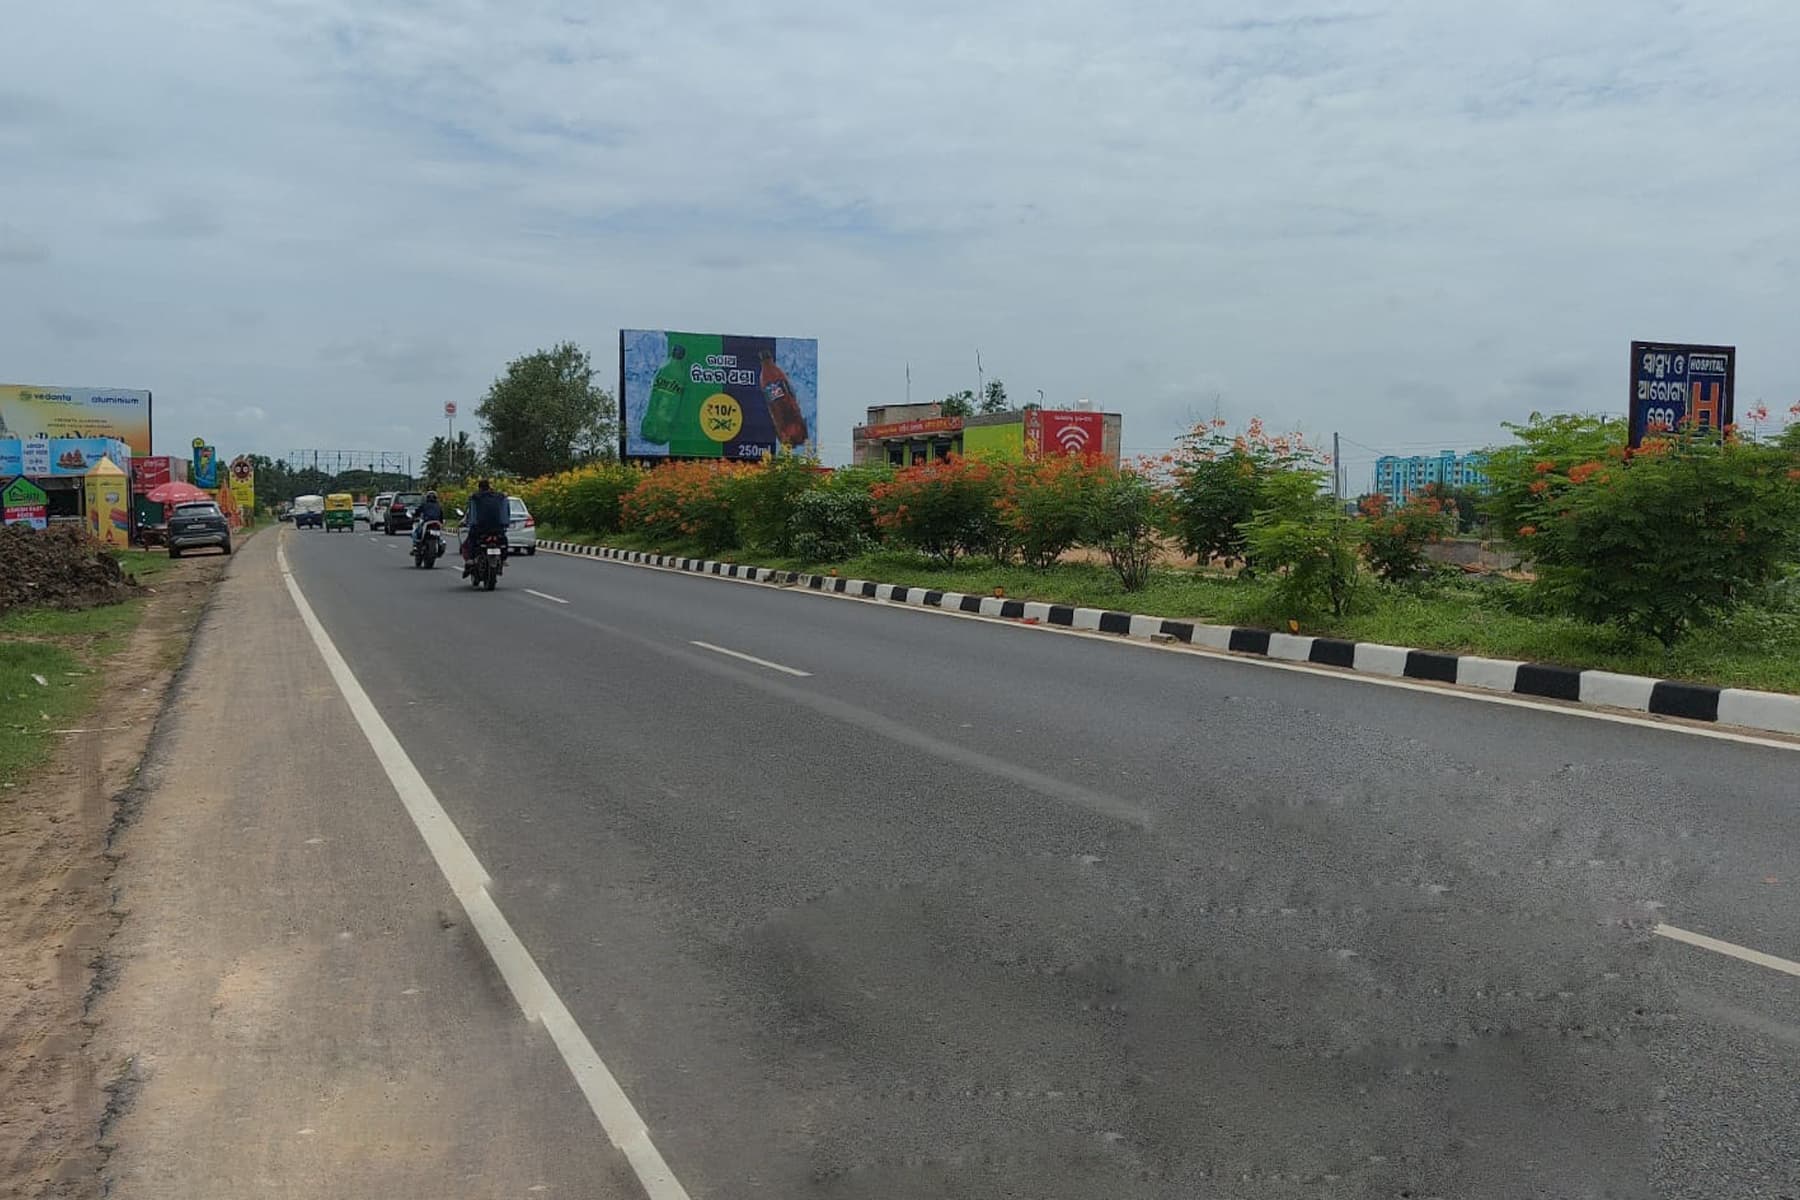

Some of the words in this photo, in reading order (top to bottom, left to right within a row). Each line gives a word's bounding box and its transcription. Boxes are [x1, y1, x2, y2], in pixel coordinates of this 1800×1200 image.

[1690, 358, 1724, 371] HOSPITAL
[33, 392, 71, 402] vedanta
[91, 395, 139, 405] aluminium
